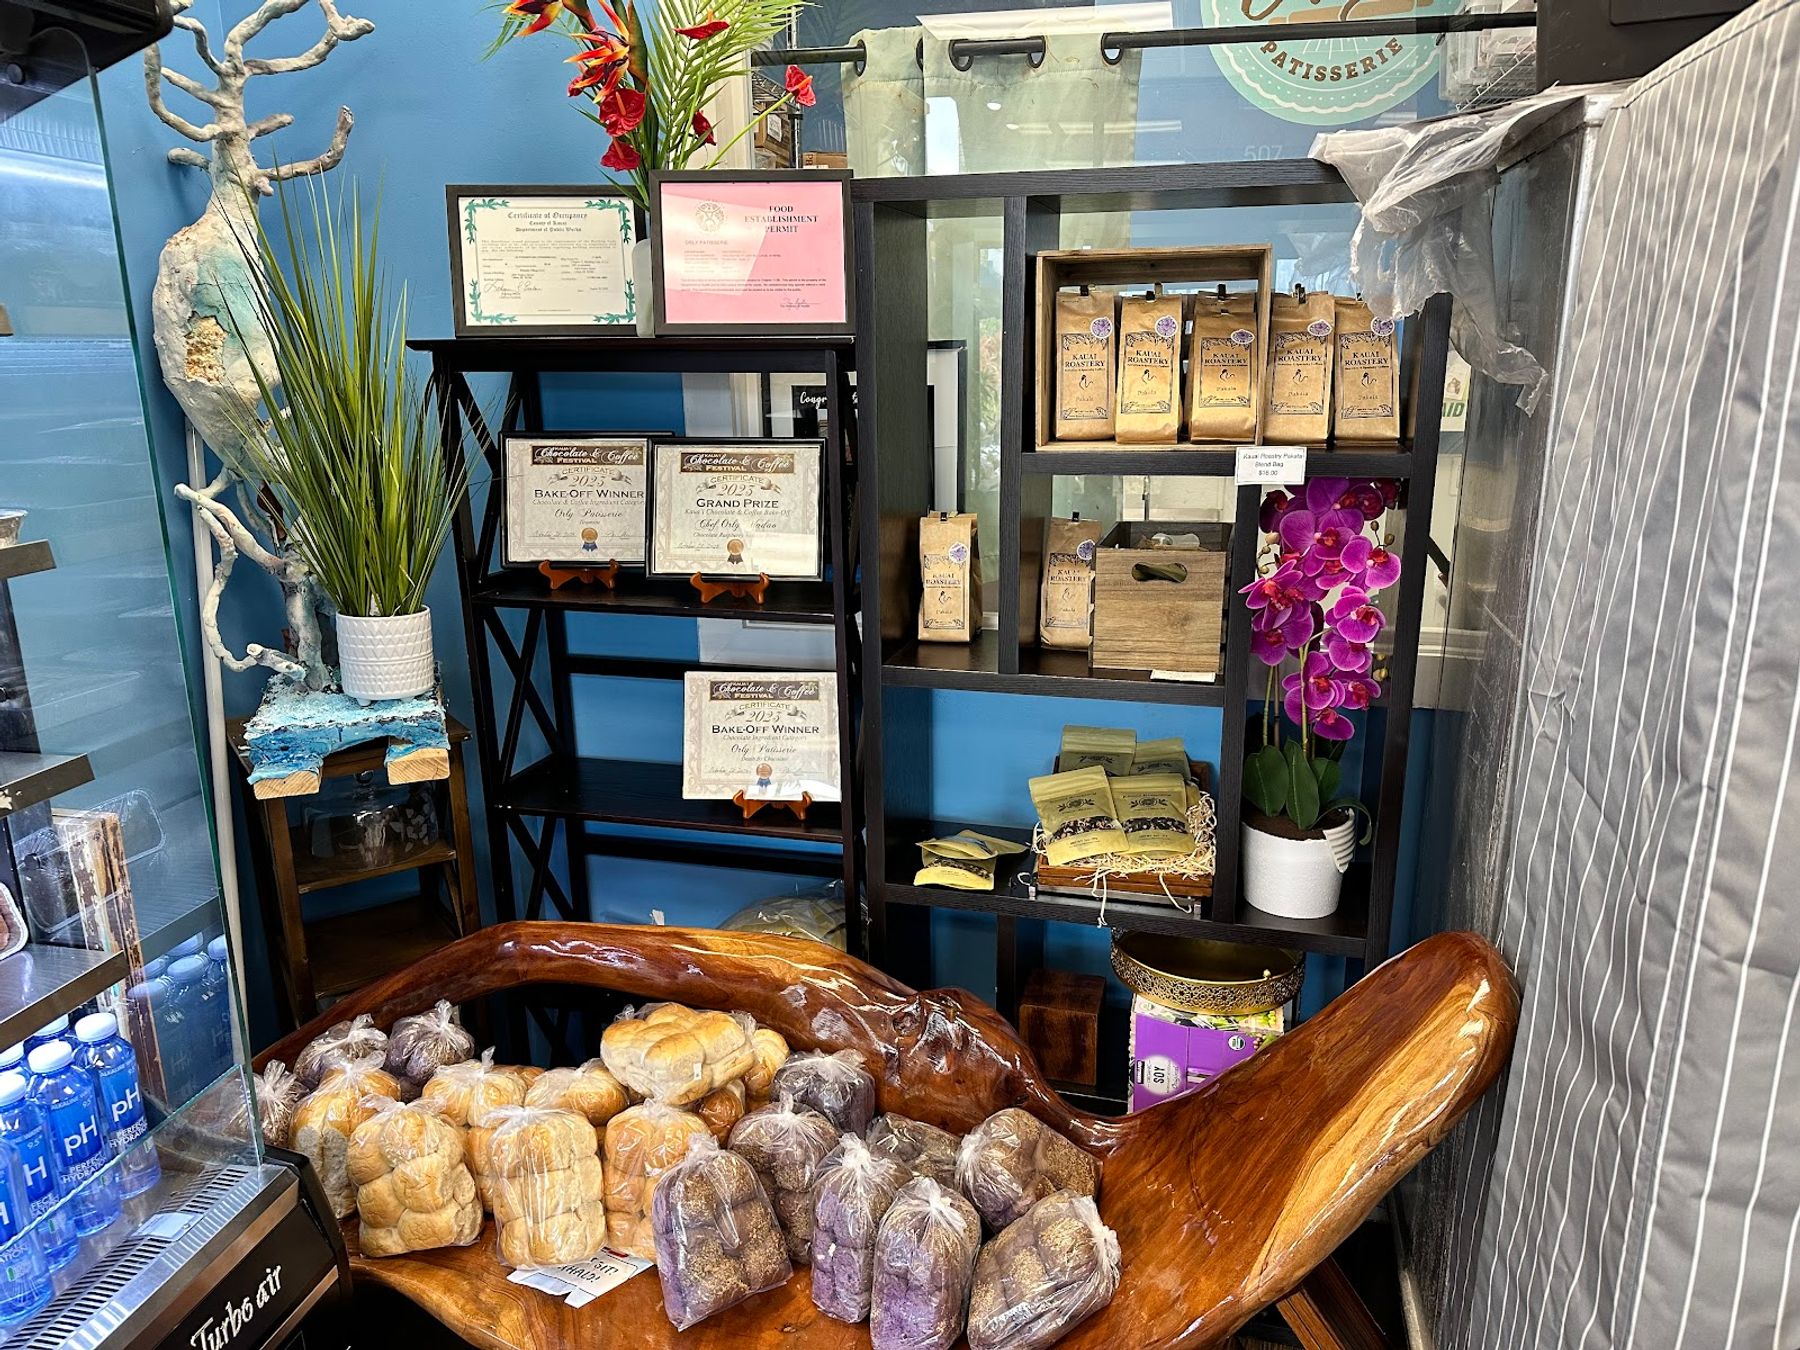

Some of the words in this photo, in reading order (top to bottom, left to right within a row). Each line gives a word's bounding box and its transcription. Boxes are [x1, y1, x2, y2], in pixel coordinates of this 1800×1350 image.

[1260, 38, 1403, 81] PATISSERIE
[1244, 144, 1282, 160] 507
[769, 205, 794, 213] FOOD
[507, 211, 543, 219] Certificate
[552, 211, 588, 220] Occupancy
[744, 215, 819, 223] ESTABLISHMENT
[765, 225, 799, 233] PERMIT
[1344, 358, 1389, 366] ROASTERY
[537, 447, 588, 458] Chocolate
[590, 447, 601, 458] &
[602, 450, 640, 465] Coffee
[557, 457, 598, 465] FESTIVAL
[687, 453, 737, 465] Chocolate
[740, 455, 751, 466] &
[752, 456, 790, 472] Coffee
[562, 466, 615, 475] CERTIFICATE
[710, 475, 763, 484] CERTIFICATE
[596, 489, 645, 499] WINNER
[696, 498, 741, 508] GRAND
[743, 498, 779, 509] PRIZE
[554, 508, 574, 520] Orly
[583, 509, 623, 518] Patisserie
[698, 519, 720, 531] Chef
[721, 519, 740, 531] Orly
[716, 682, 765, 693] Chocolate
[767, 682, 779, 694] &
[780, 685, 816, 700] Coffee
[739, 701, 791, 710] CERTIFICATE
[712, 725, 770, 734] BAKE-OFF
[772, 725, 820, 734] WINNER
[731, 744, 751, 756] Orly
[759, 744, 797, 753] Patisserie
[1153, 1066, 1165, 1084] SOY
[111, 1082, 141, 1122] pH
[64, 1114, 98, 1157] pH
[23, 1155, 48, 1187] H
[190, 1296, 255, 1350] Turbo
[256, 1264, 282, 1309] air
